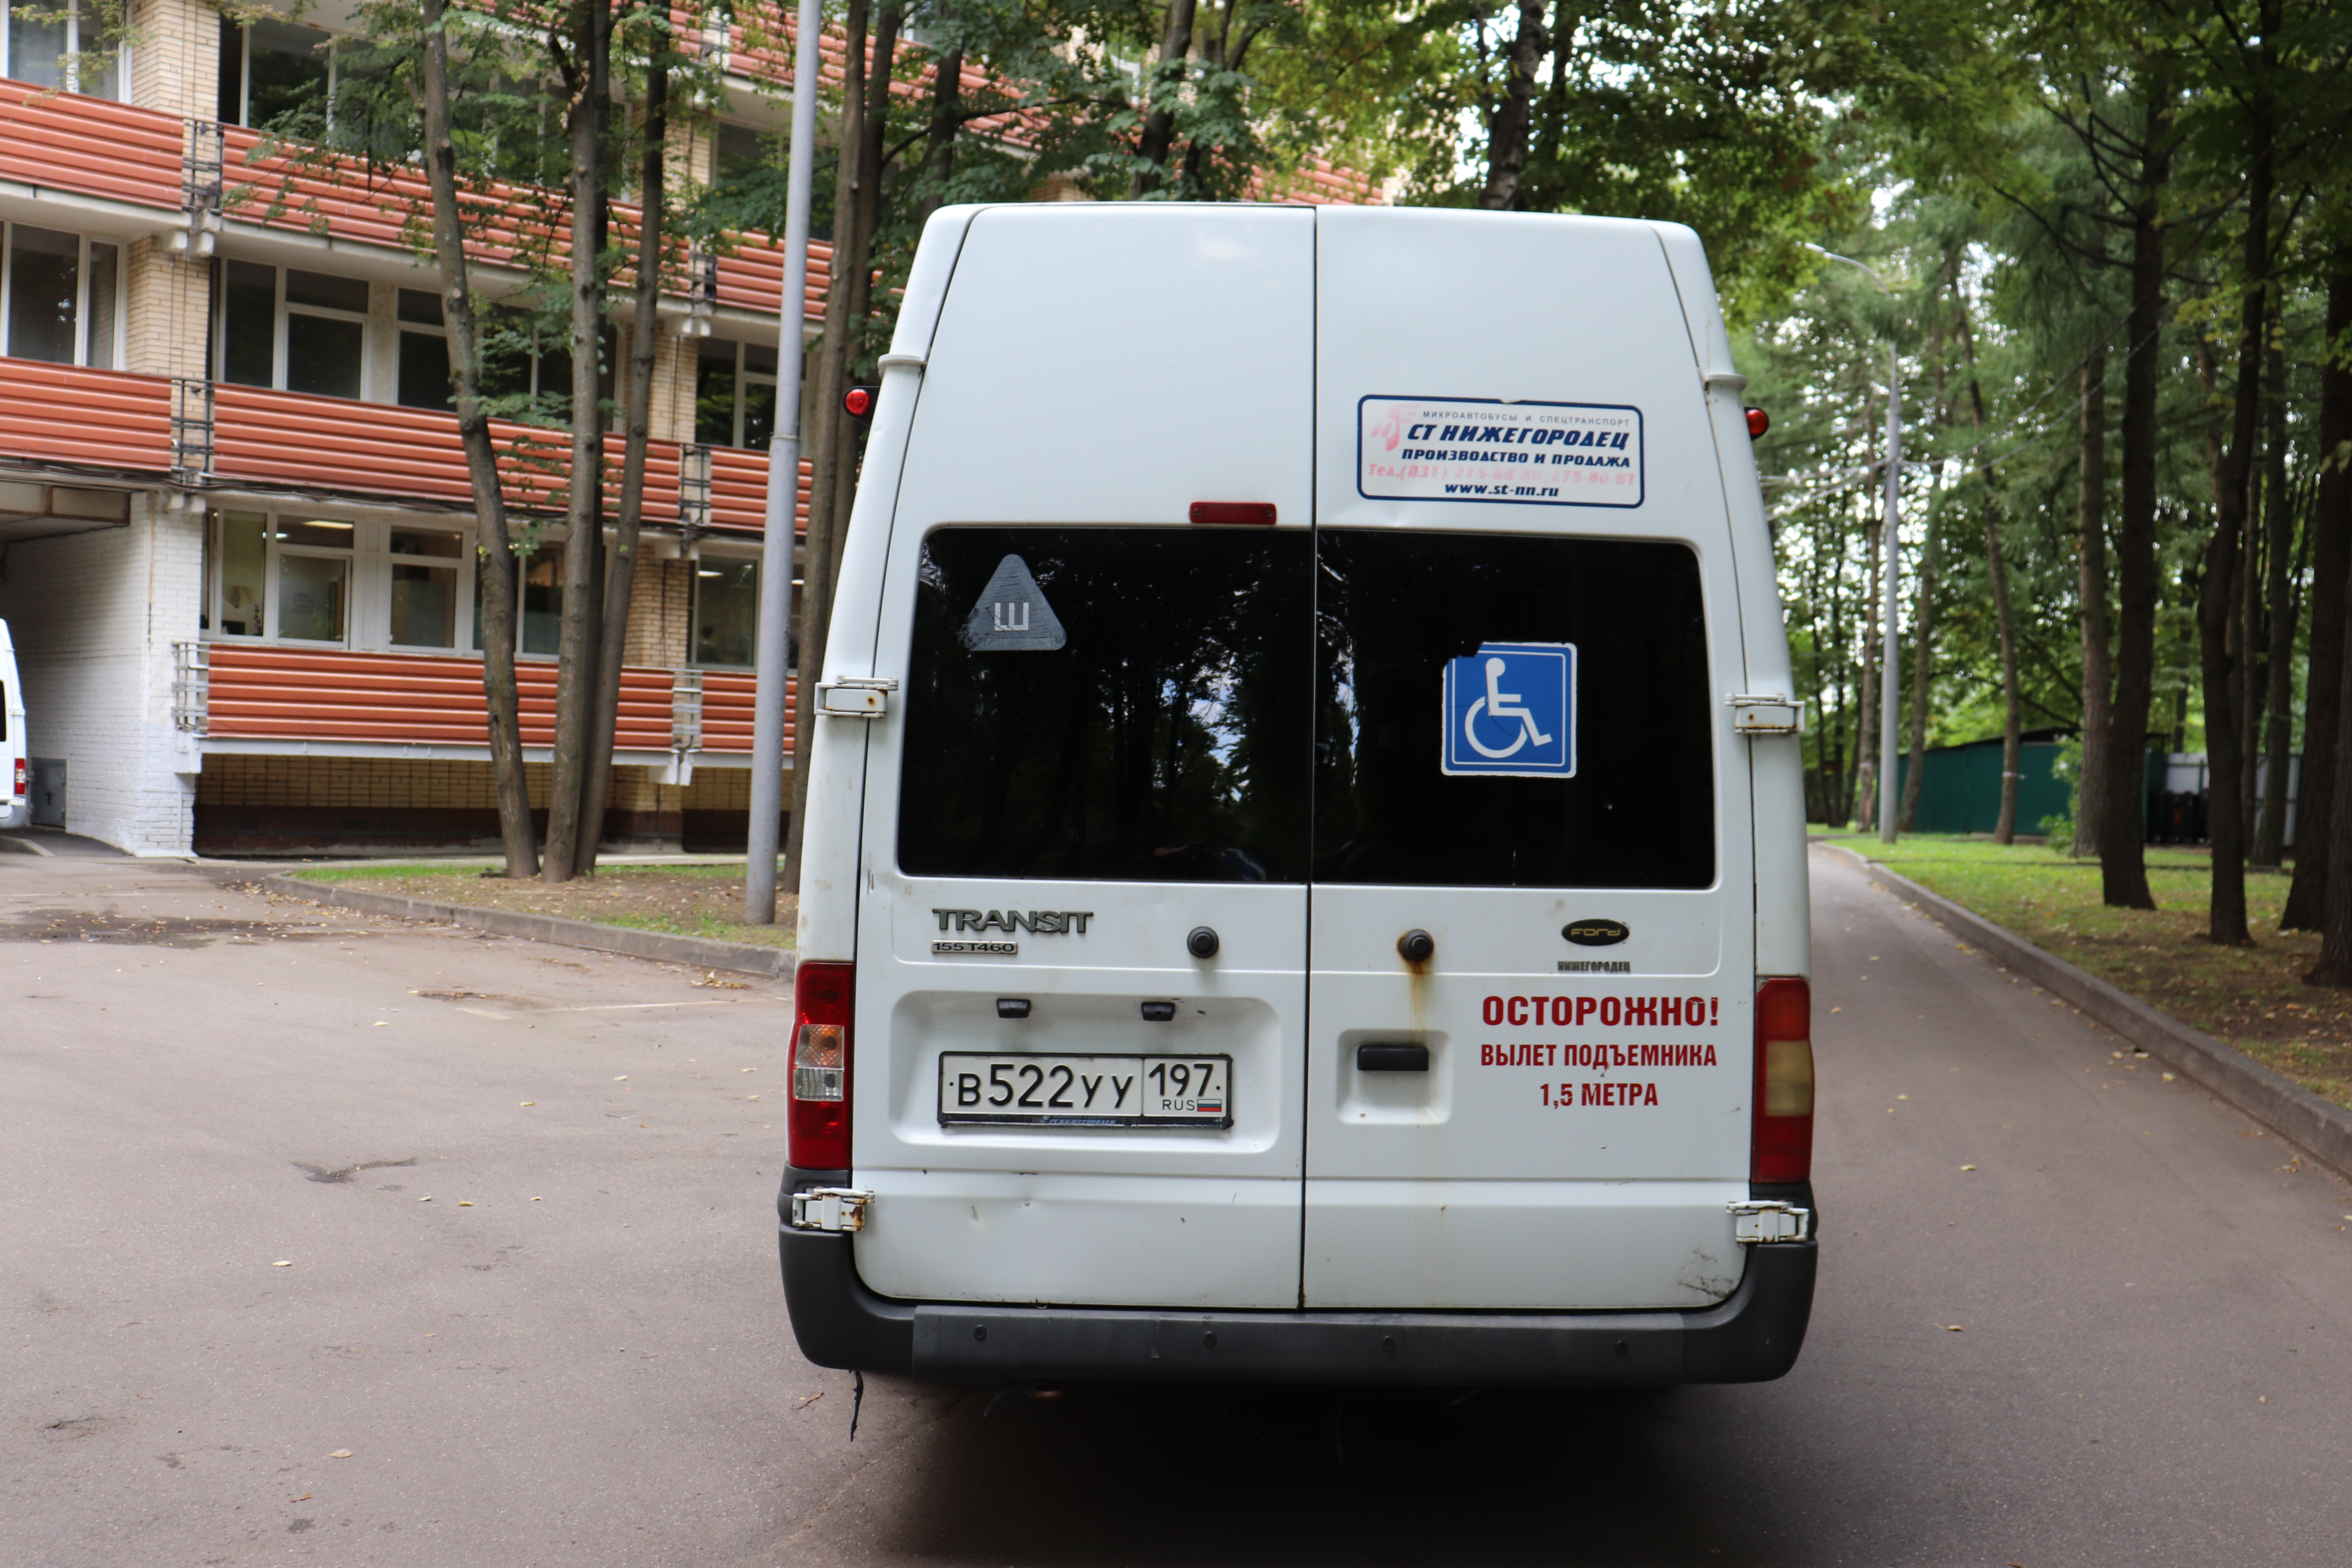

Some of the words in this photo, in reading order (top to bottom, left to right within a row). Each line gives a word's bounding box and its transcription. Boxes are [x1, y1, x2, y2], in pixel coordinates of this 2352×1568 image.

[1423, 411, 1517, 421] МИКРОАВТОБУСЫ
[1540, 416, 1630, 426] СПЕЦТРАНСПОРТ
[1407, 424, 1437, 440] СТ
[1439, 425, 1630, 450] НИЖЕГОРОДЕЦ
[1401, 448, 1529, 463] ПРОИЗВОДСТВО
[1534, 453, 1546, 464] И
[1551, 454, 1630, 467] ПРОДАЖА
[1445, 484, 1559, 497] www.st-nn.ru
[994, 602, 1029, 631] Ш
[932, 908, 1094, 933] TRANSIT
[1557, 961, 1631, 973] НИЖЕГОРОДЕЦ
[1483, 996, 1719, 1026] ОСТОРОЖНО!
[1481, 1044, 1557, 1066] ВЫЛЕТ
[1565, 1045, 1717, 1070] ПОДЪЕМНИКА
[1148, 1063, 1214, 1097] 197
[1162, 1099, 1196, 1111] RUS
[1541, 1083, 1573, 1109] 1,5
[1581, 1083, 1659, 1106] МЕТРА
